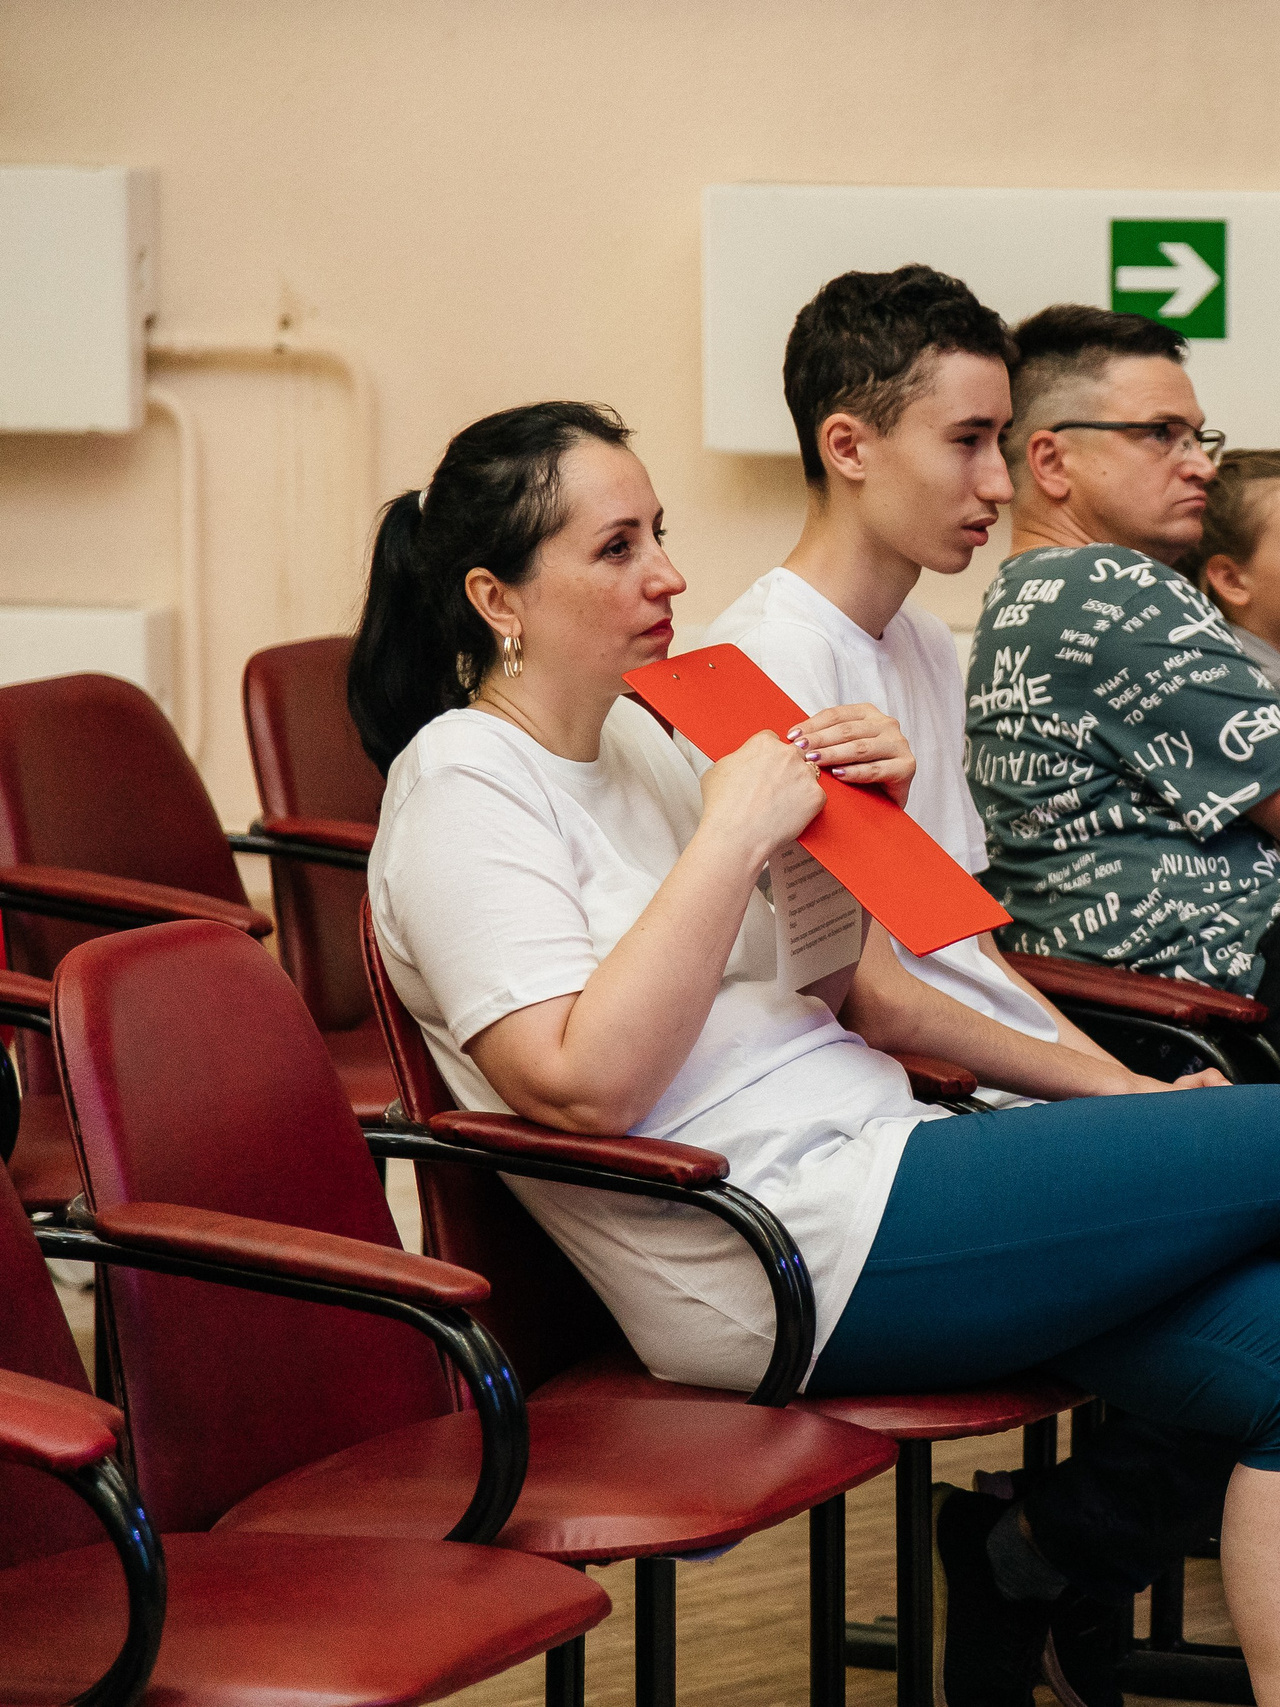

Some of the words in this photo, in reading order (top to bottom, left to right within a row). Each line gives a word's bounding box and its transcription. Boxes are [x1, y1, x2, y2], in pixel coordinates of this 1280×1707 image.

[1016, 578, 1066, 604] FEAR
[992, 603, 1036, 631] LESS
[1060, 628, 1099, 648] MEAN
[1055, 647, 1094, 666] WHAT
[1093, 667, 1131, 698] WHAT
[1108, 683, 1143, 711] DOES
[1163, 647, 1204, 673] MEAN
[968, 672, 1053, 718] HOME
[1123, 709, 1145, 727] TO
[1140, 693, 1163, 711] BE
[1157, 674, 1187, 696] THE
[975, 744, 1095, 786] BRUTALITY
[1053, 810, 1105, 850] TRIP
[1072, 852, 1096, 873] WHAT
[1095, 859, 1124, 880] ABOUT
[1069, 891, 1120, 941] TRIP
[1130, 887, 1163, 919] WHAT
